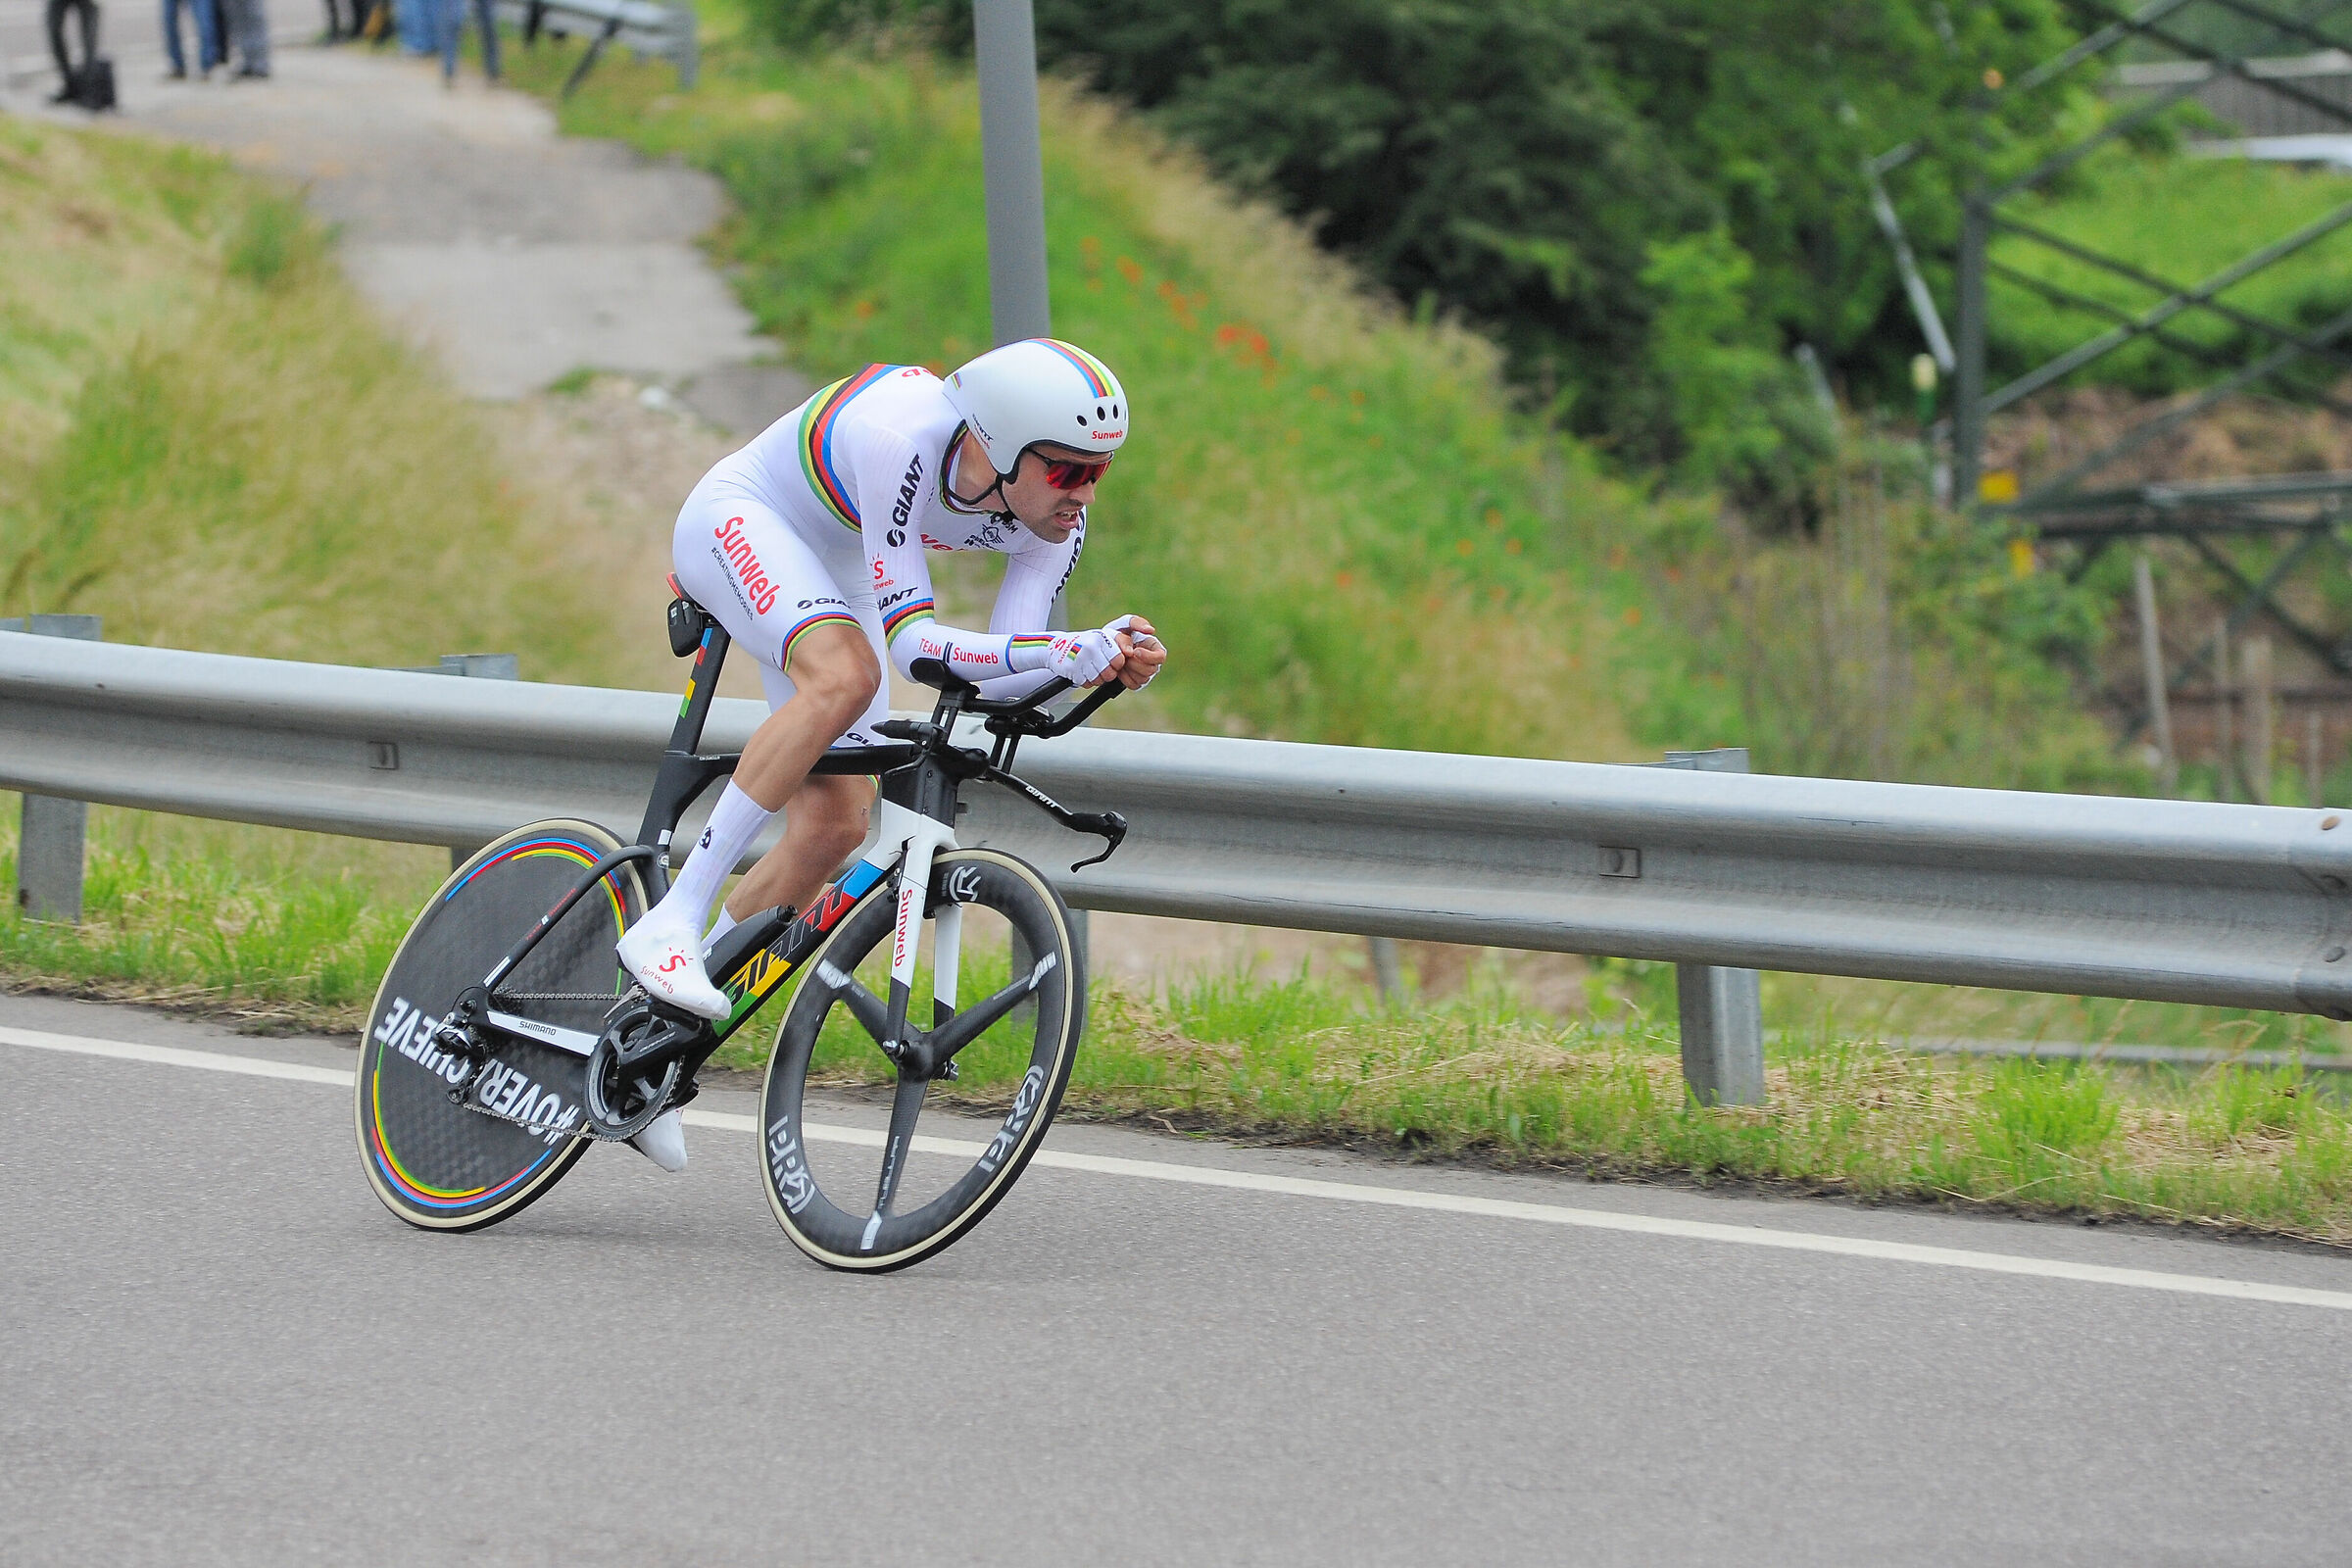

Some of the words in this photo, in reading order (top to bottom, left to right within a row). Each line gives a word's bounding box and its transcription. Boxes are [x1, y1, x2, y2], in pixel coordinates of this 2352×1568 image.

[1092, 430, 1123, 440] Sunweb
[892, 453, 924, 527] GIANT
[714, 516, 781, 615] Sunweb
[710, 547, 754, 621] #CREATINGMEMORIES
[876, 587, 918, 612] IANT
[919, 637, 942, 658] TEAM
[953, 647, 999, 664] Sunweb
[894, 888, 913, 967] Sunweb
[640, 965, 674, 995] Sunweb
[518, 1020, 557, 1036] SHIMANO
